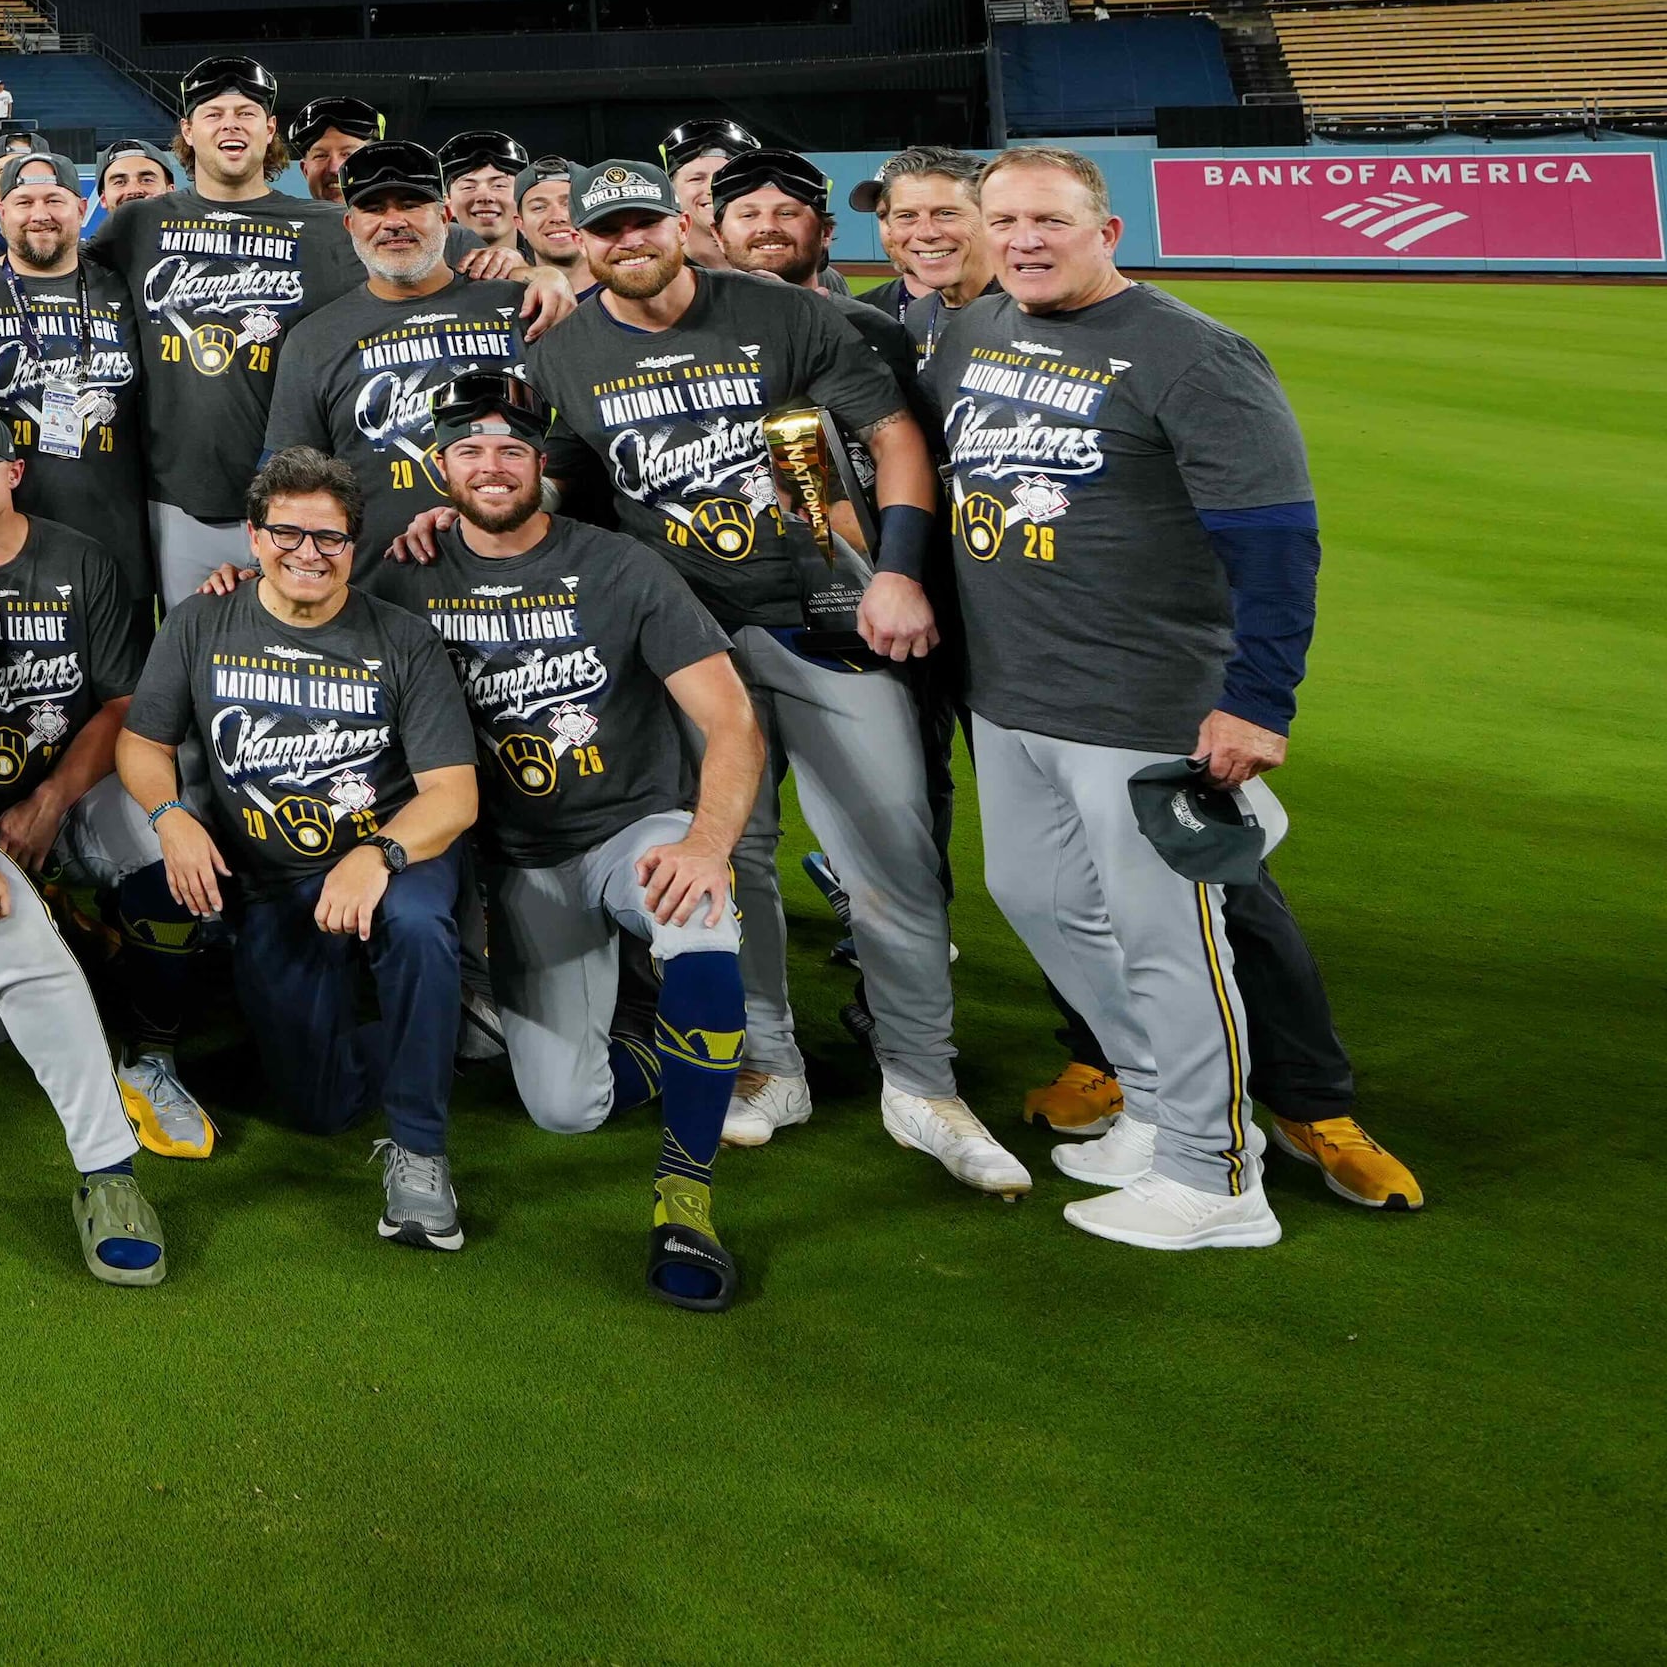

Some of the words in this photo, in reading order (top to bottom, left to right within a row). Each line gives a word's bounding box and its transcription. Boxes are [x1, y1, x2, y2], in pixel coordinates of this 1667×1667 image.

[1204, 165, 1310, 186] BANK
[1326, 164, 1375, 185] OF
[1389, 161, 1592, 184] AMERICA
[581, 188, 621, 212] WORLD
[622, 184, 662, 201] SERIES
[160, 220, 231, 232] MILWAUKEE
[160, 231, 231, 255] NATIONAL
[237, 235, 296, 261] LEAGUE
[143, 253, 305, 315] Champions
[161, 335, 181, 362] 20
[248, 345, 270, 372] 26
[362, 338, 441, 369] NATIONAL
[446, 334, 511, 358] LEAGUE
[971, 347, 1033, 371] MILWAUKEE
[1038, 359, 1116, 385] BREWERS
[593, 368, 675, 396] MILWAUKEE
[683, 361, 761, 380] BREWERS
[963, 363, 1029, 399] NATIONAL
[1030, 375, 1102, 416] LEAGUE
[600, 386, 689, 428] NATIONAL
[691, 378, 762, 412] LEAGUE
[942, 394, 1105, 479] Champions
[784, 442, 824, 528] NATIONAL
[1024, 524, 1056, 561] 26
[213, 653, 298, 674] MILWAUKEE
[215, 669, 302, 707] NATIONAL
[309, 678, 377, 715] LEAGUE
[211, 704, 390, 787] Champions
[242, 807, 267, 841] 20
